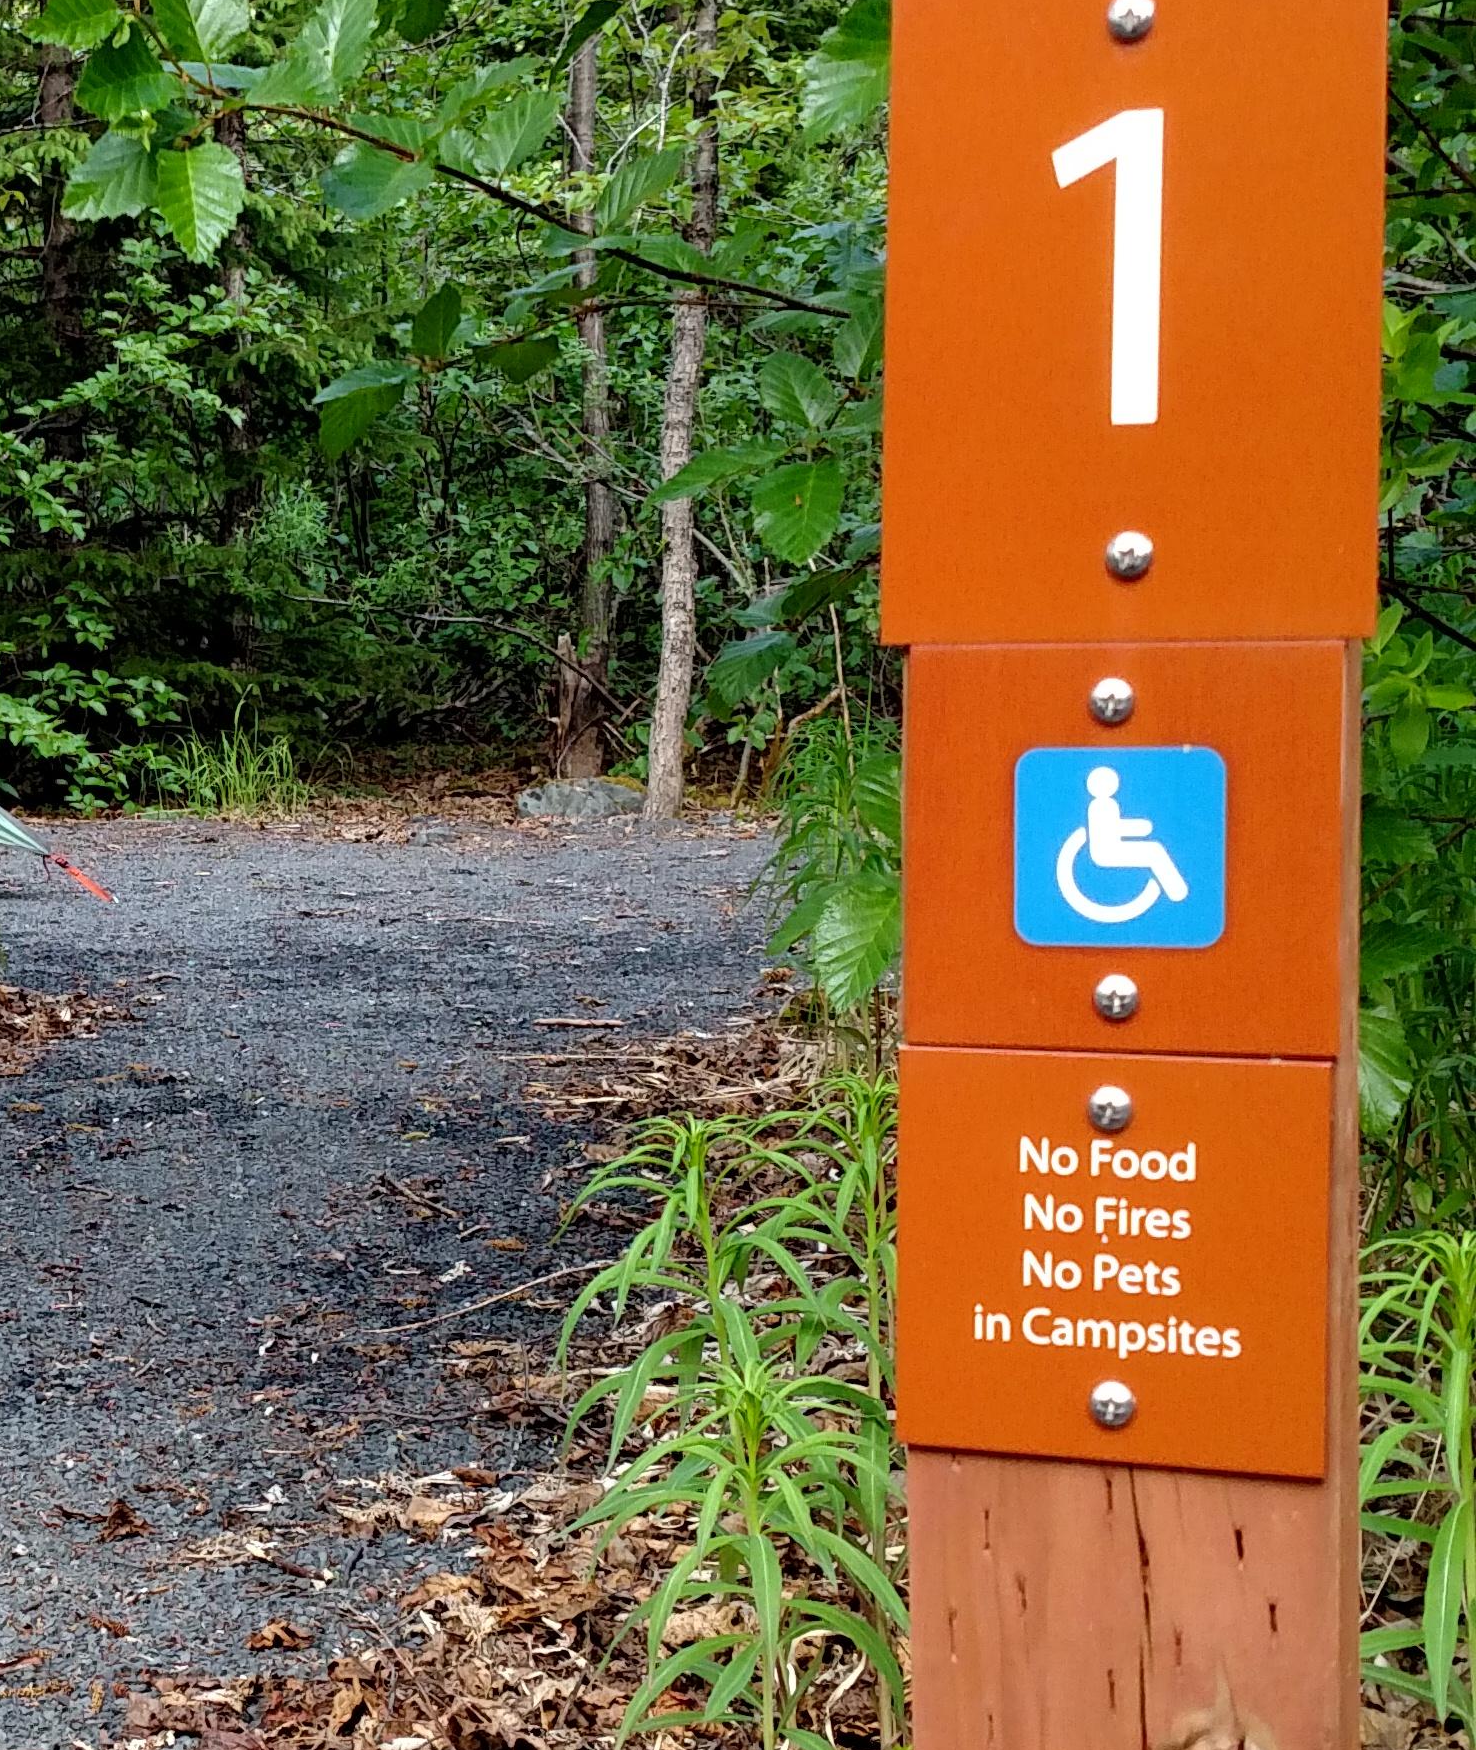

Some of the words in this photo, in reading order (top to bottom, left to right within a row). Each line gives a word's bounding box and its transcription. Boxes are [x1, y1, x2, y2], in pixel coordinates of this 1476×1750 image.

[1052, 107, 1164, 425] 1
[1019, 1136, 1078, 1176] No
[1090, 1139, 1197, 1182] Food
[1024, 1194, 1083, 1233] No
[1095, 1197, 1192, 1240] Fires
[1023, 1250, 1082, 1290] No
[1093, 1254, 1181, 1297] Pets
[974, 1304, 1011, 1342] in
[1022, 1307, 1242, 1359] Campsites
